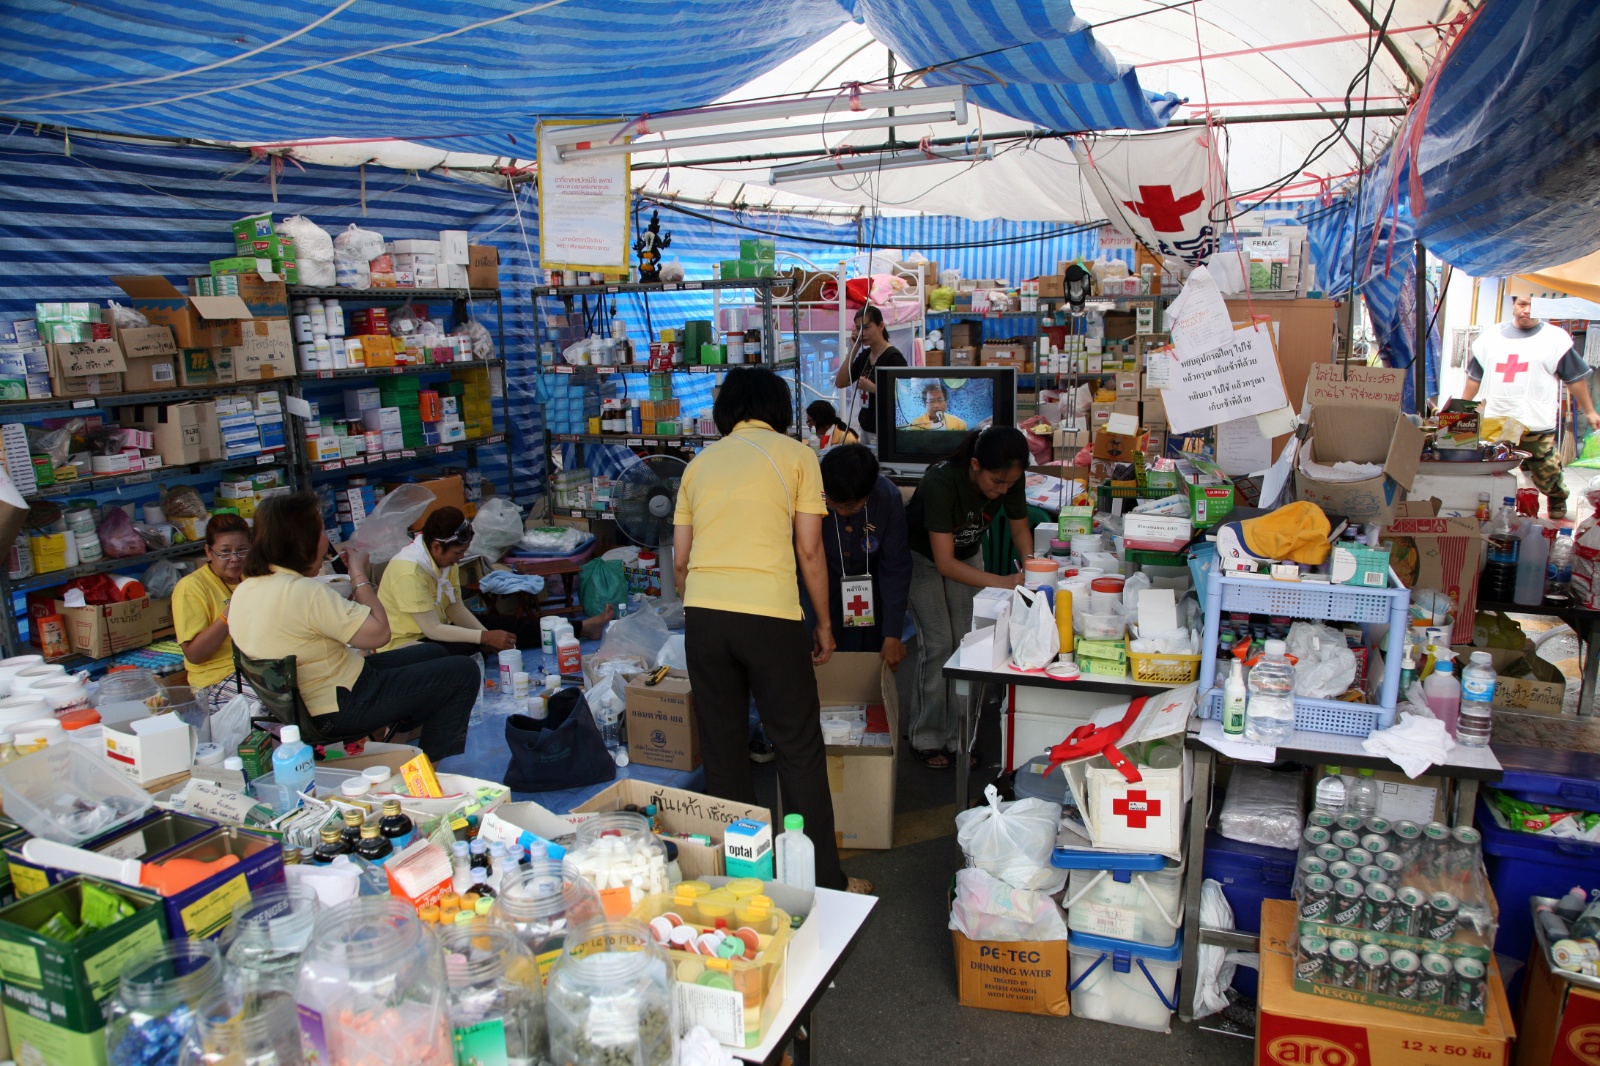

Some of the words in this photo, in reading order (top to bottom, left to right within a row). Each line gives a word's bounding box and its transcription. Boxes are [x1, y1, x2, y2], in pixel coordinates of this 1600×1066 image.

[1233, 340, 1252, 353] ไปใช้
[1212, 382, 1230, 394] ไปใช้
[1231, 376, 1266, 391] แล้วกรุณา
[1208, 393, 1252, 411] เก็บเข้าที่ด้วย
[1456, 420, 1476, 428] fudo
[729, 844, 753, 859] optal
[1316, 926, 1372, 943] NESCAFÉ
[980, 945, 1041, 963] PE-TEC
[970, 960, 1017, 976] DRINKING
[1019, 968, 1051, 977] WATER
[984, 983, 1008, 991] REVERSE
[993, 977, 1018, 985] TREATED
[1313, 985, 1368, 1003] NESCAFÉ
[1277, 1039, 1349, 1066] aro
[1401, 1039, 1424, 1051] 12
[1427, 1044, 1439, 1053] x
[1444, 1044, 1467, 1056] 50
